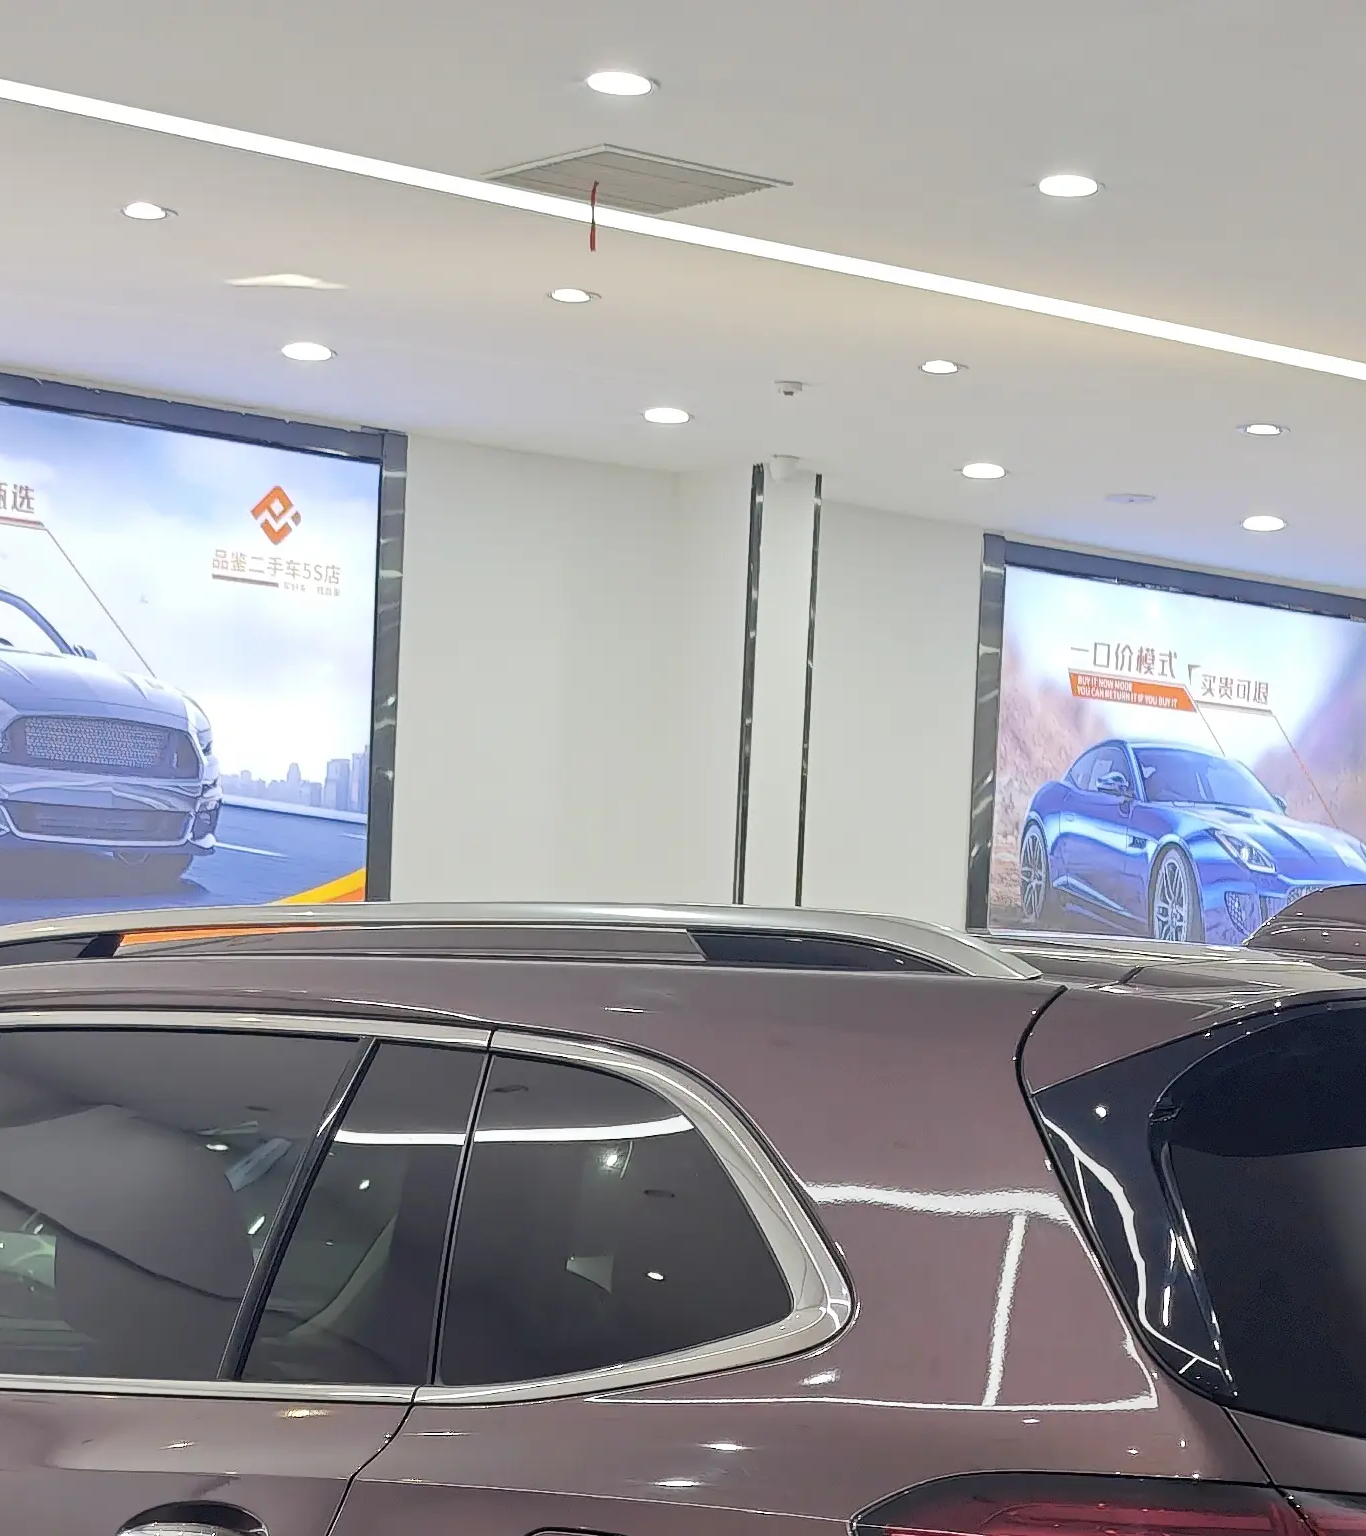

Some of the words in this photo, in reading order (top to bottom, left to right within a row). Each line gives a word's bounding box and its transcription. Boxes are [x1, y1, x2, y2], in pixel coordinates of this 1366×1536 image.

[1070, 642, 1179, 679] 一口价模式
[1099, 677, 1115, 689] NOW
[1091, 687, 1104, 699] CAN
